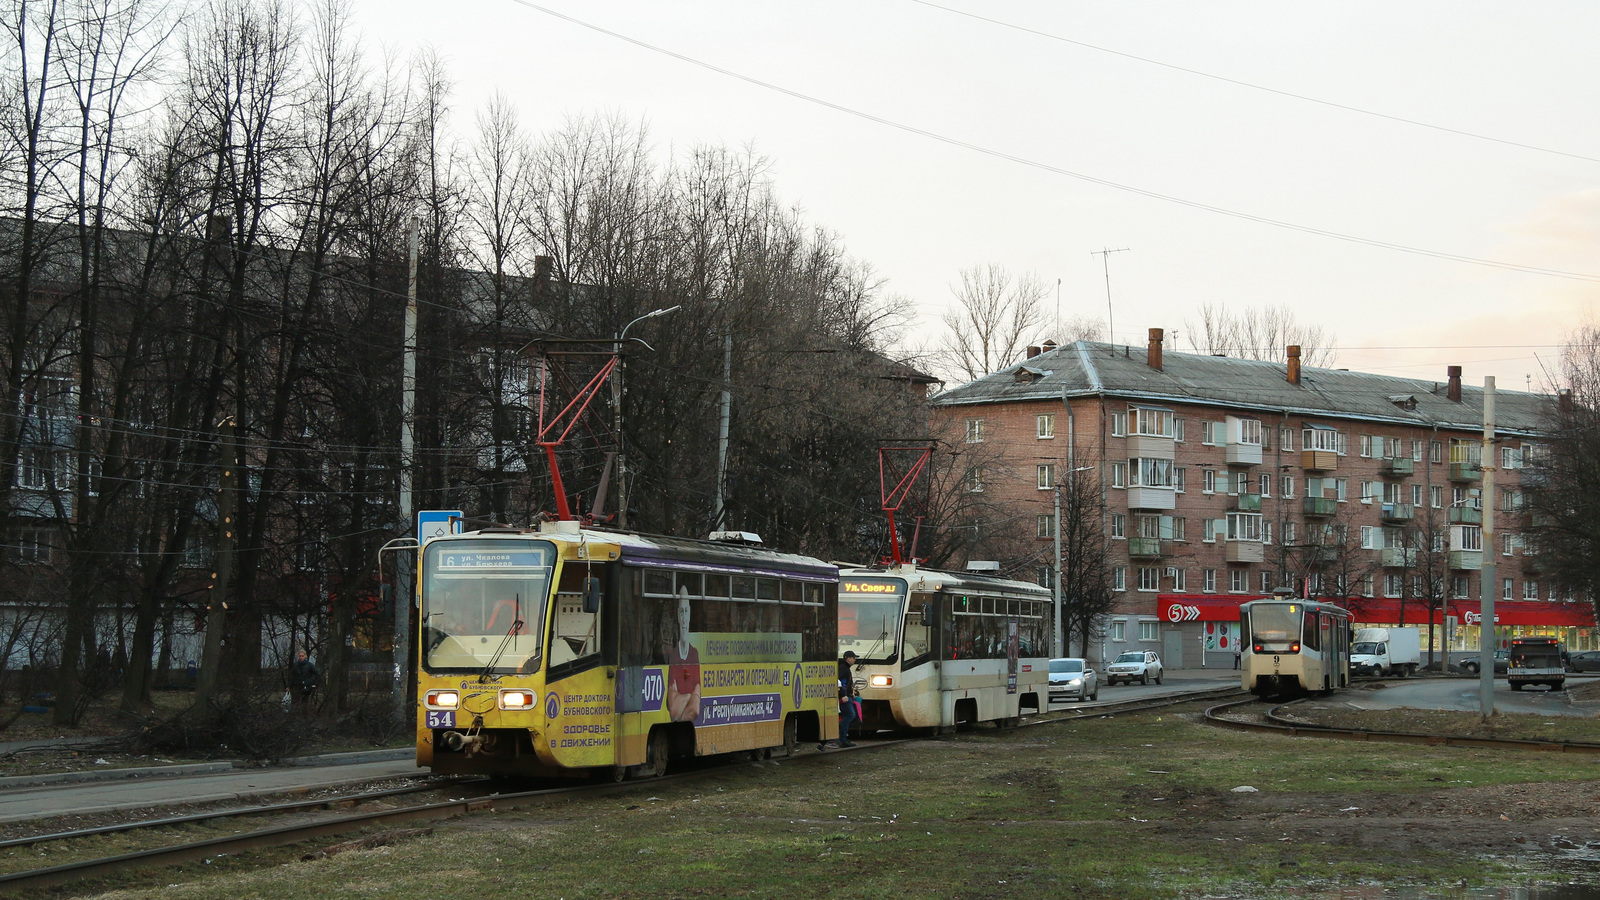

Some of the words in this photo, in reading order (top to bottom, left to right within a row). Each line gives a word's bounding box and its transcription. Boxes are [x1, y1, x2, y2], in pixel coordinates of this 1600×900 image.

[446, 556, 455, 567] 6
[845, 583, 860, 592] Ул.
[1289, 605, 1296, 613] 5
[706, 640, 730, 656] ЛЕЧЕНИЕ
[774, 640, 797, 655] СУСТАВОВ
[1273, 655, 1280, 663] 9
[806, 666, 818, 678] ЦЕНТР
[818, 665, 836, 678] ДОКТОРА
[703, 670, 715, 688] БЕЗ
[716, 669, 745, 687] ЛЕКАРСТВ
[746, 669, 750, 685] И
[563, 695, 583, 703] ЦЕНТР
[584, 694, 611, 703] ДОКТОРА
[765, 696, 774, 714] 42
[563, 706, 611, 716] БУБНОВСКОГО
[429, 711, 453, 727] 54
[563, 724, 611, 734] ЗДОРОВЬЕ
[550, 739, 557, 748] В
[560, 738, 611, 748] ДВИЖЕНИИ
